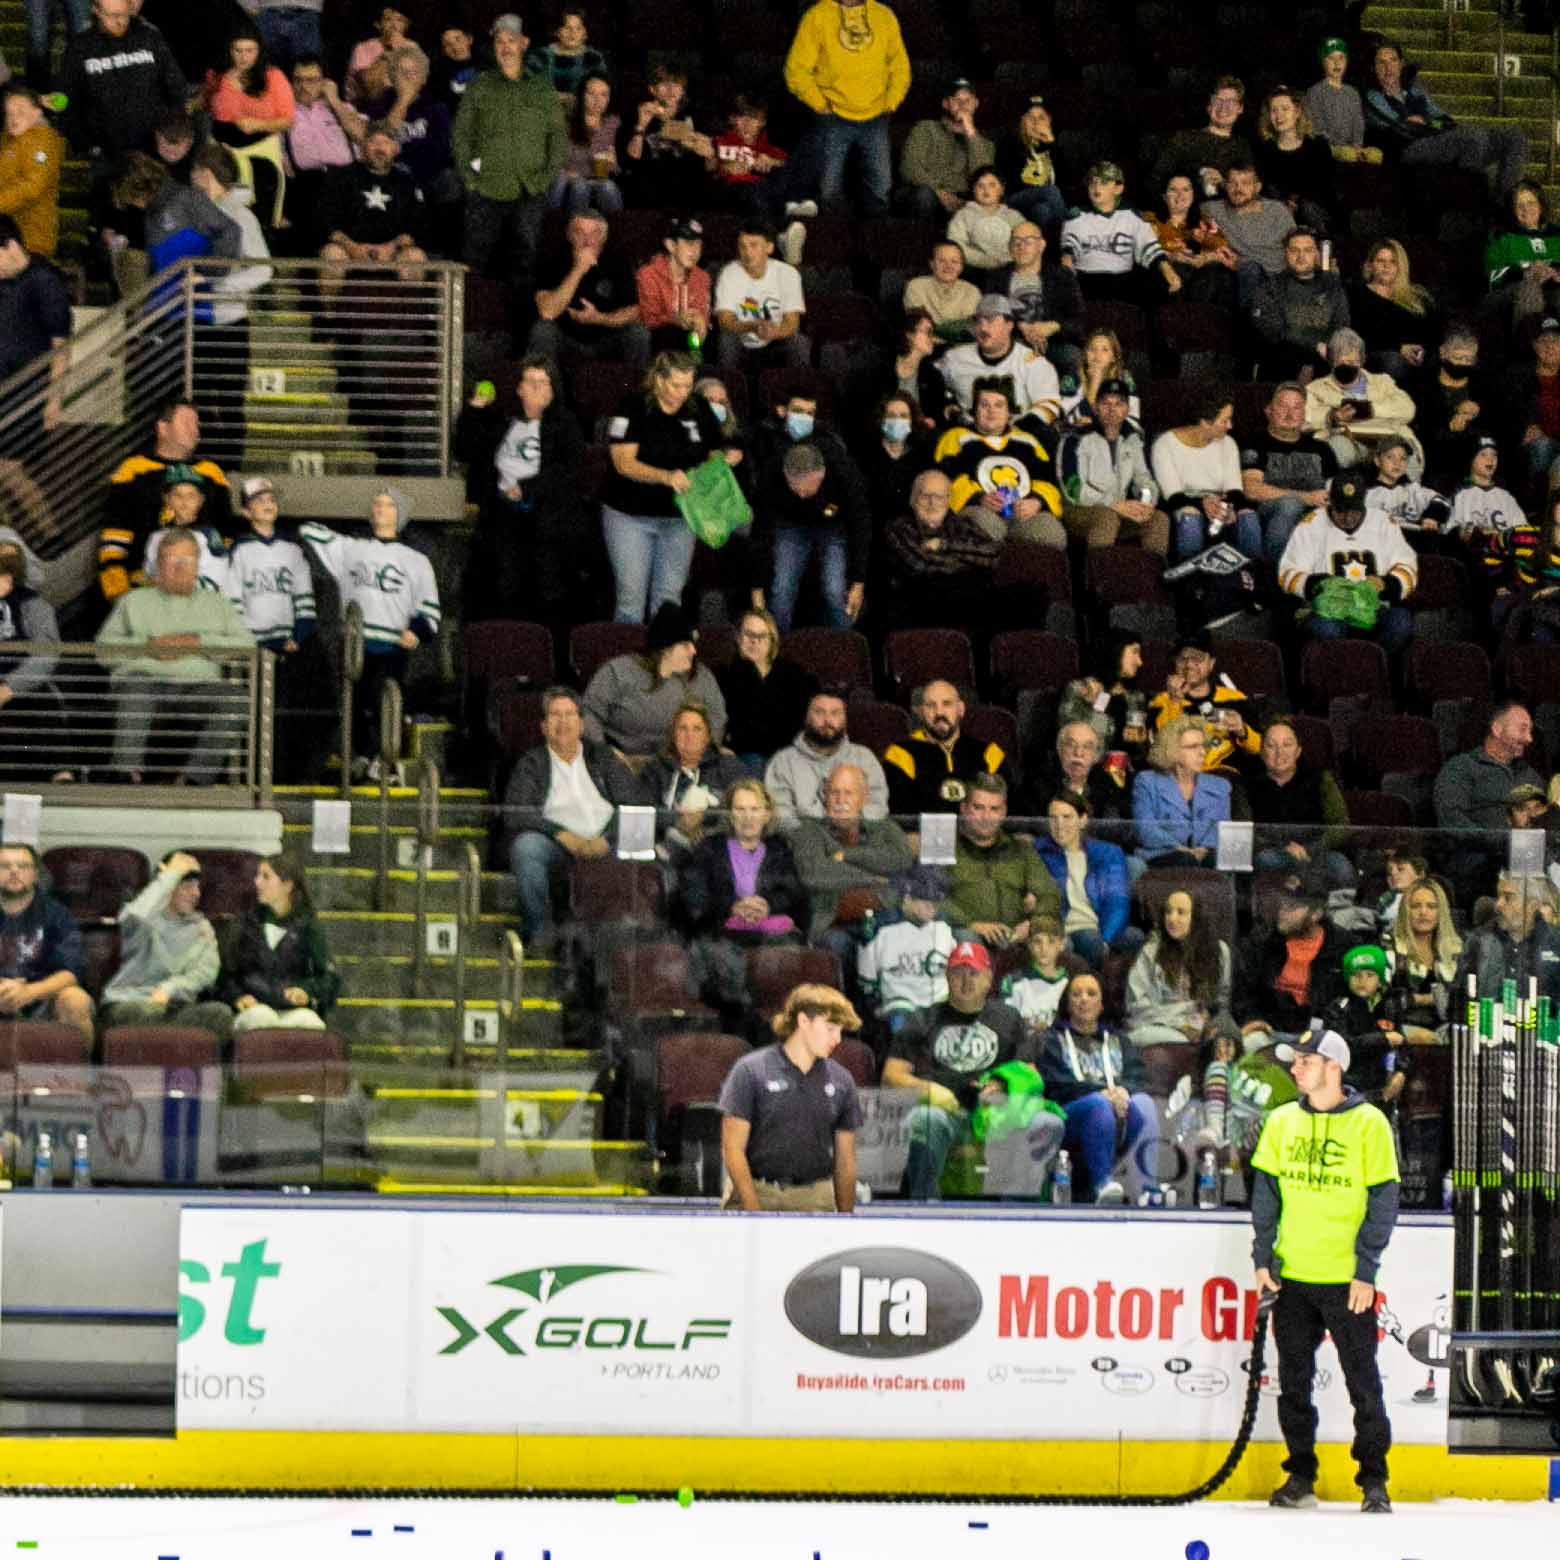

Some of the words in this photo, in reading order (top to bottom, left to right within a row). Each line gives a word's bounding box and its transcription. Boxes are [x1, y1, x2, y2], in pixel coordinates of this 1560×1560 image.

[839, 1266, 928, 1336] Ira
[998, 1275, 1183, 1341] Motor
[612, 1363, 721, 1381] PORTLAND
